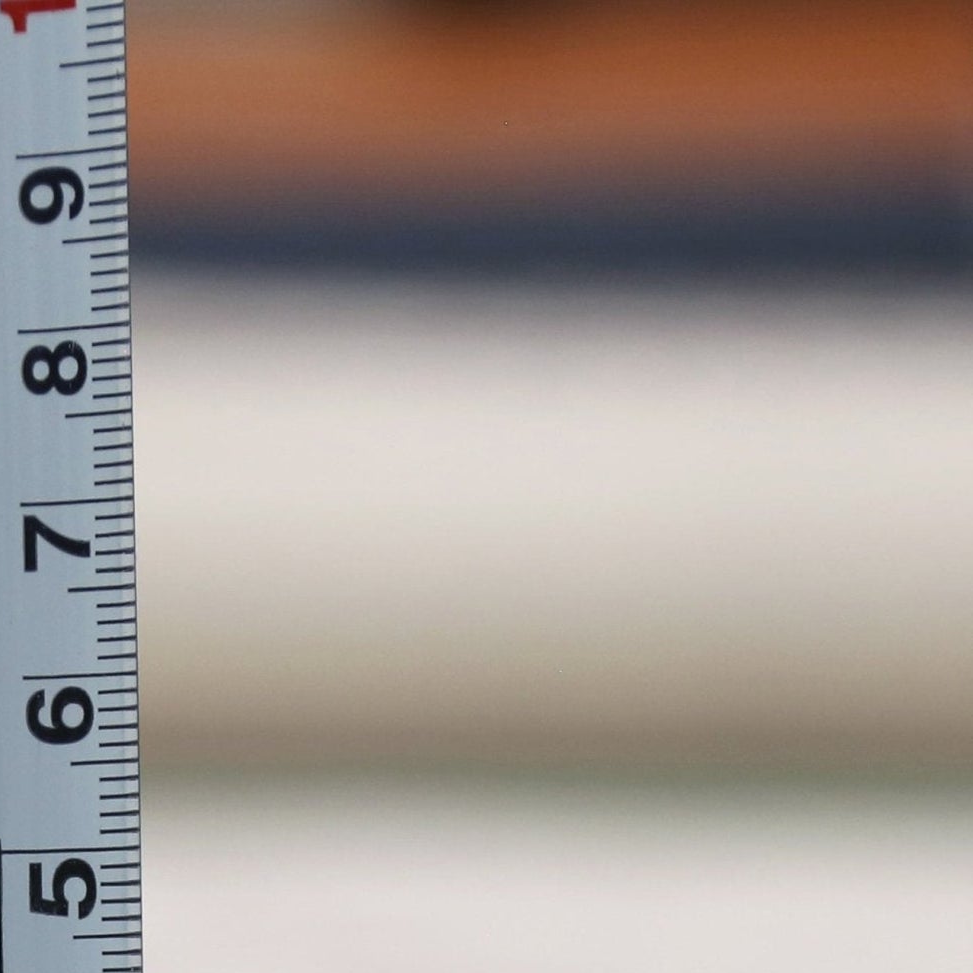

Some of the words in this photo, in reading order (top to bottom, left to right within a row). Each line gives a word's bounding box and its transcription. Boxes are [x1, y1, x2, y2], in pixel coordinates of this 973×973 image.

[19, 166, 85, 225] 9
[22, 339, 88, 396] 8
[24, 515, 91, 572] 7
[26, 687, 94, 745] 6
[29, 858, 97, 920] 5
